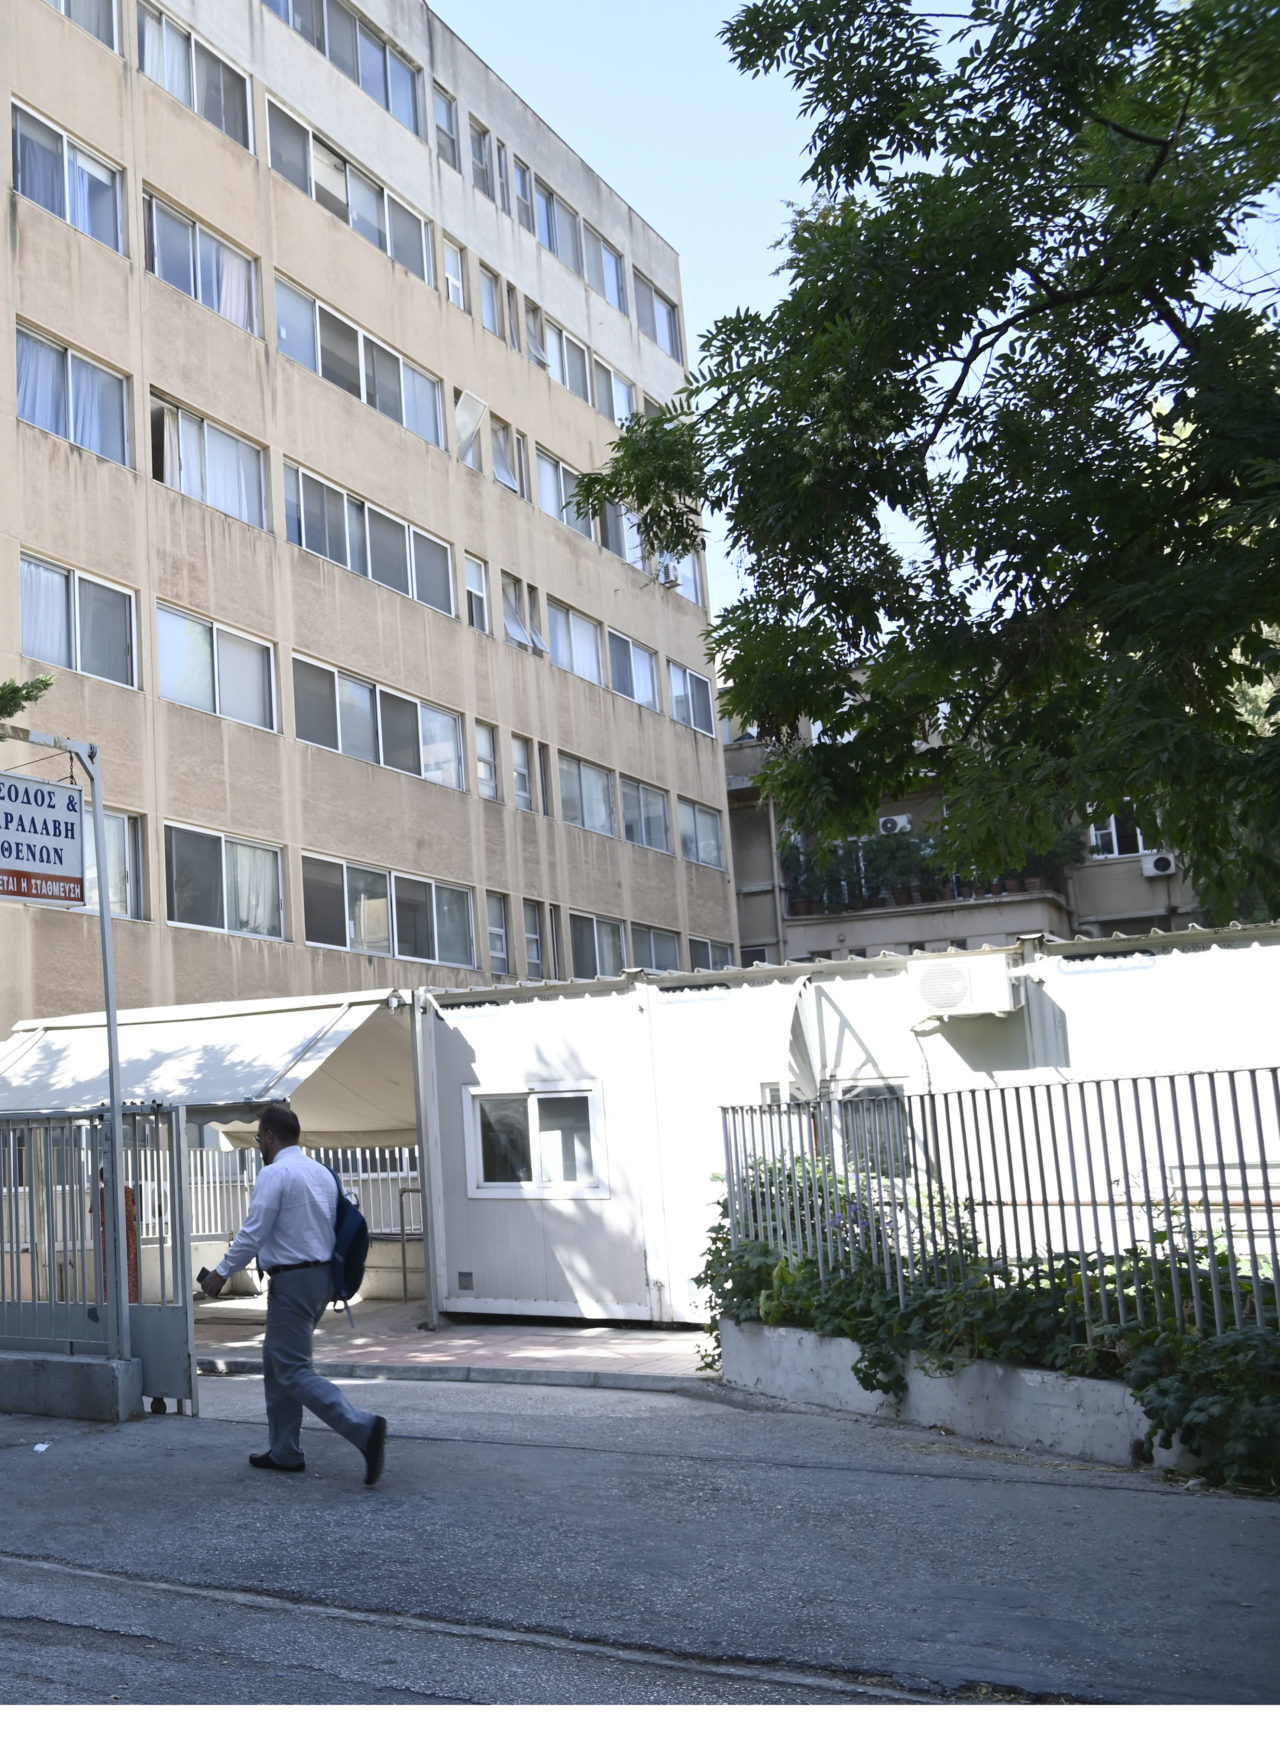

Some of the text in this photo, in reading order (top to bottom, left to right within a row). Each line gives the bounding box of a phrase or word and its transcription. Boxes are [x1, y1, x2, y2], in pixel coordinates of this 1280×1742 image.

[66, 794, 78, 813] &
[21, 878, 27, 893] Η
[31, 879, 81, 898] ΣΤΑΘΜΕΥΣΗ
